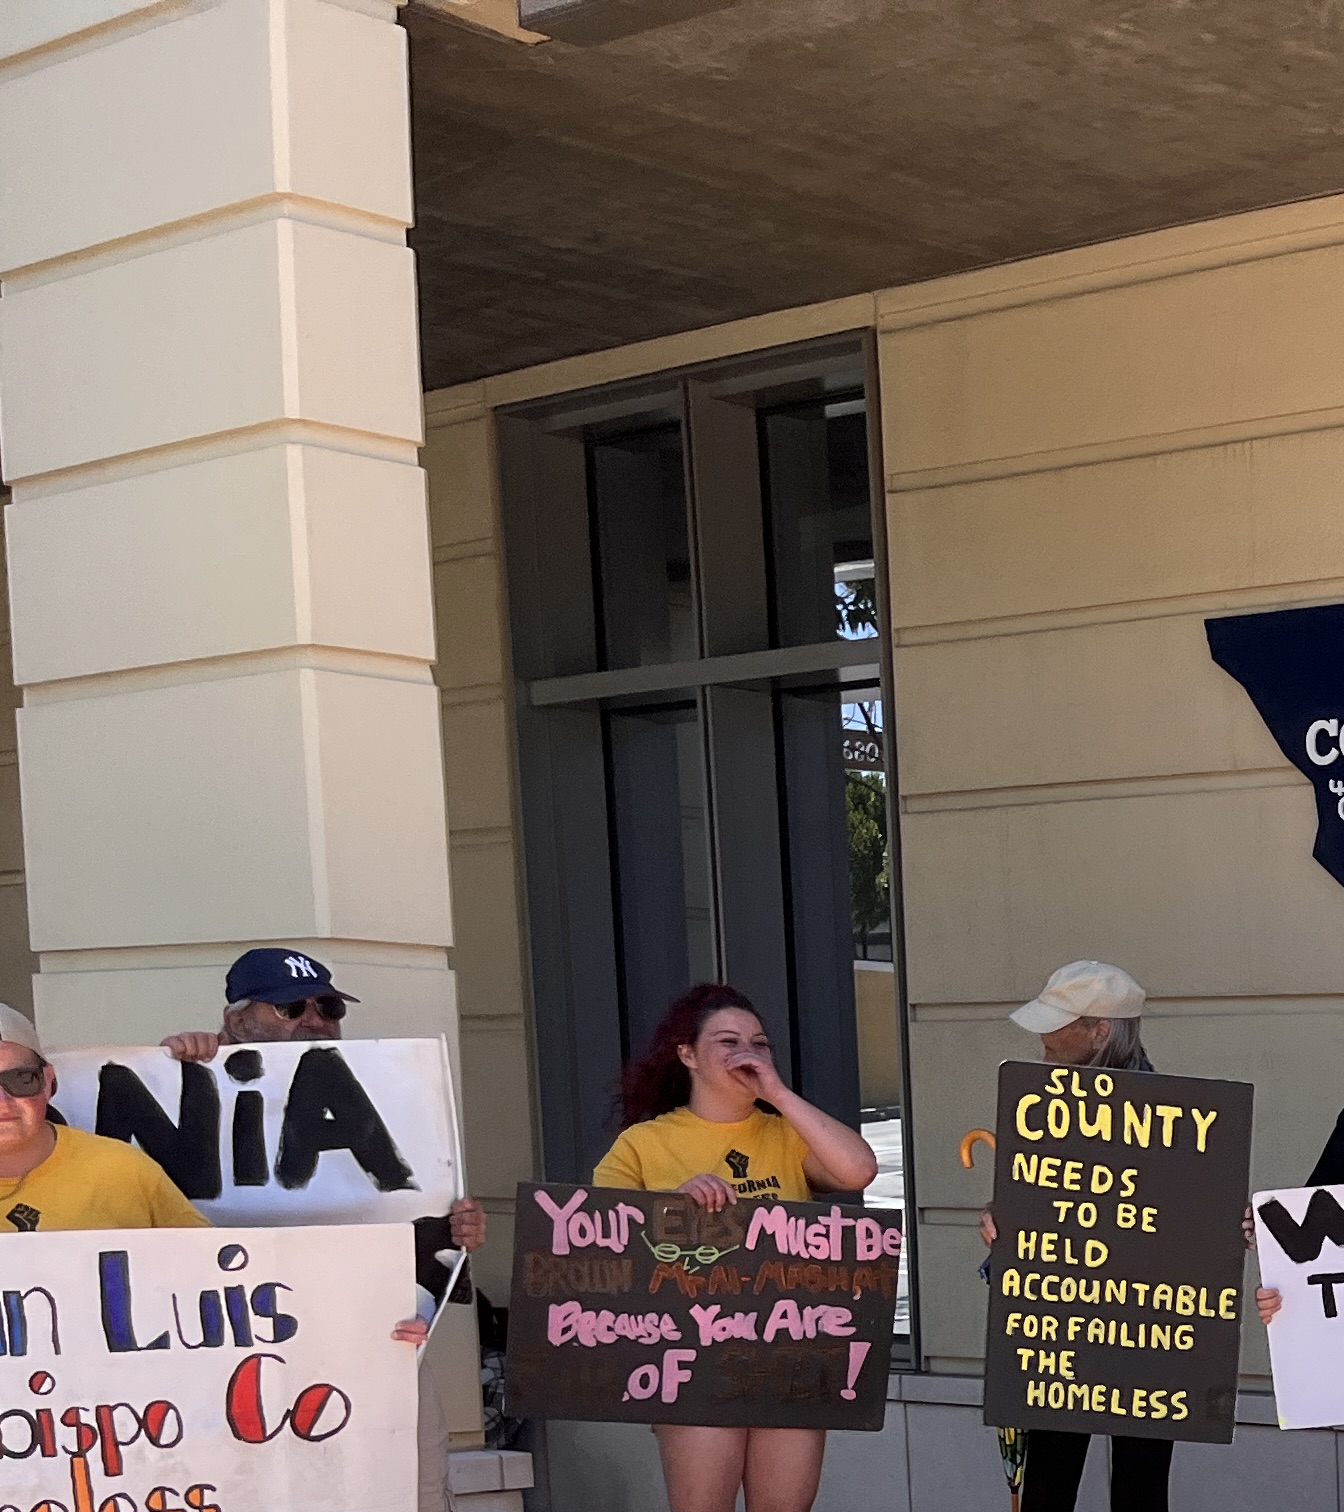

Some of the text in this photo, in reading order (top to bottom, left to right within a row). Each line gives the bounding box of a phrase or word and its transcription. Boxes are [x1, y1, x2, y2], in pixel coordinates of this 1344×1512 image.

[1045, 1068, 1114, 1097] SLO
[1016, 1094, 1218, 1153] COUNTY
[1012, 1153, 1139, 1197] NEEDS
[534, 1189, 644, 1255] Your
[1053, 1201, 1158, 1233] TO BE
[1017, 1231, 1109, 1268] HELD
[99, 1244, 298, 1352] Luis
[1002, 1269, 1238, 1320] ACCOUNTABLE
[548, 1300, 682, 1347] Because
[763, 1300, 857, 1343] Are
[1005, 1313, 1195, 1351] FOR FAILING
[1016, 1348, 1075, 1380] THE
[1027, 1381, 1189, 1421] HOMELESS
